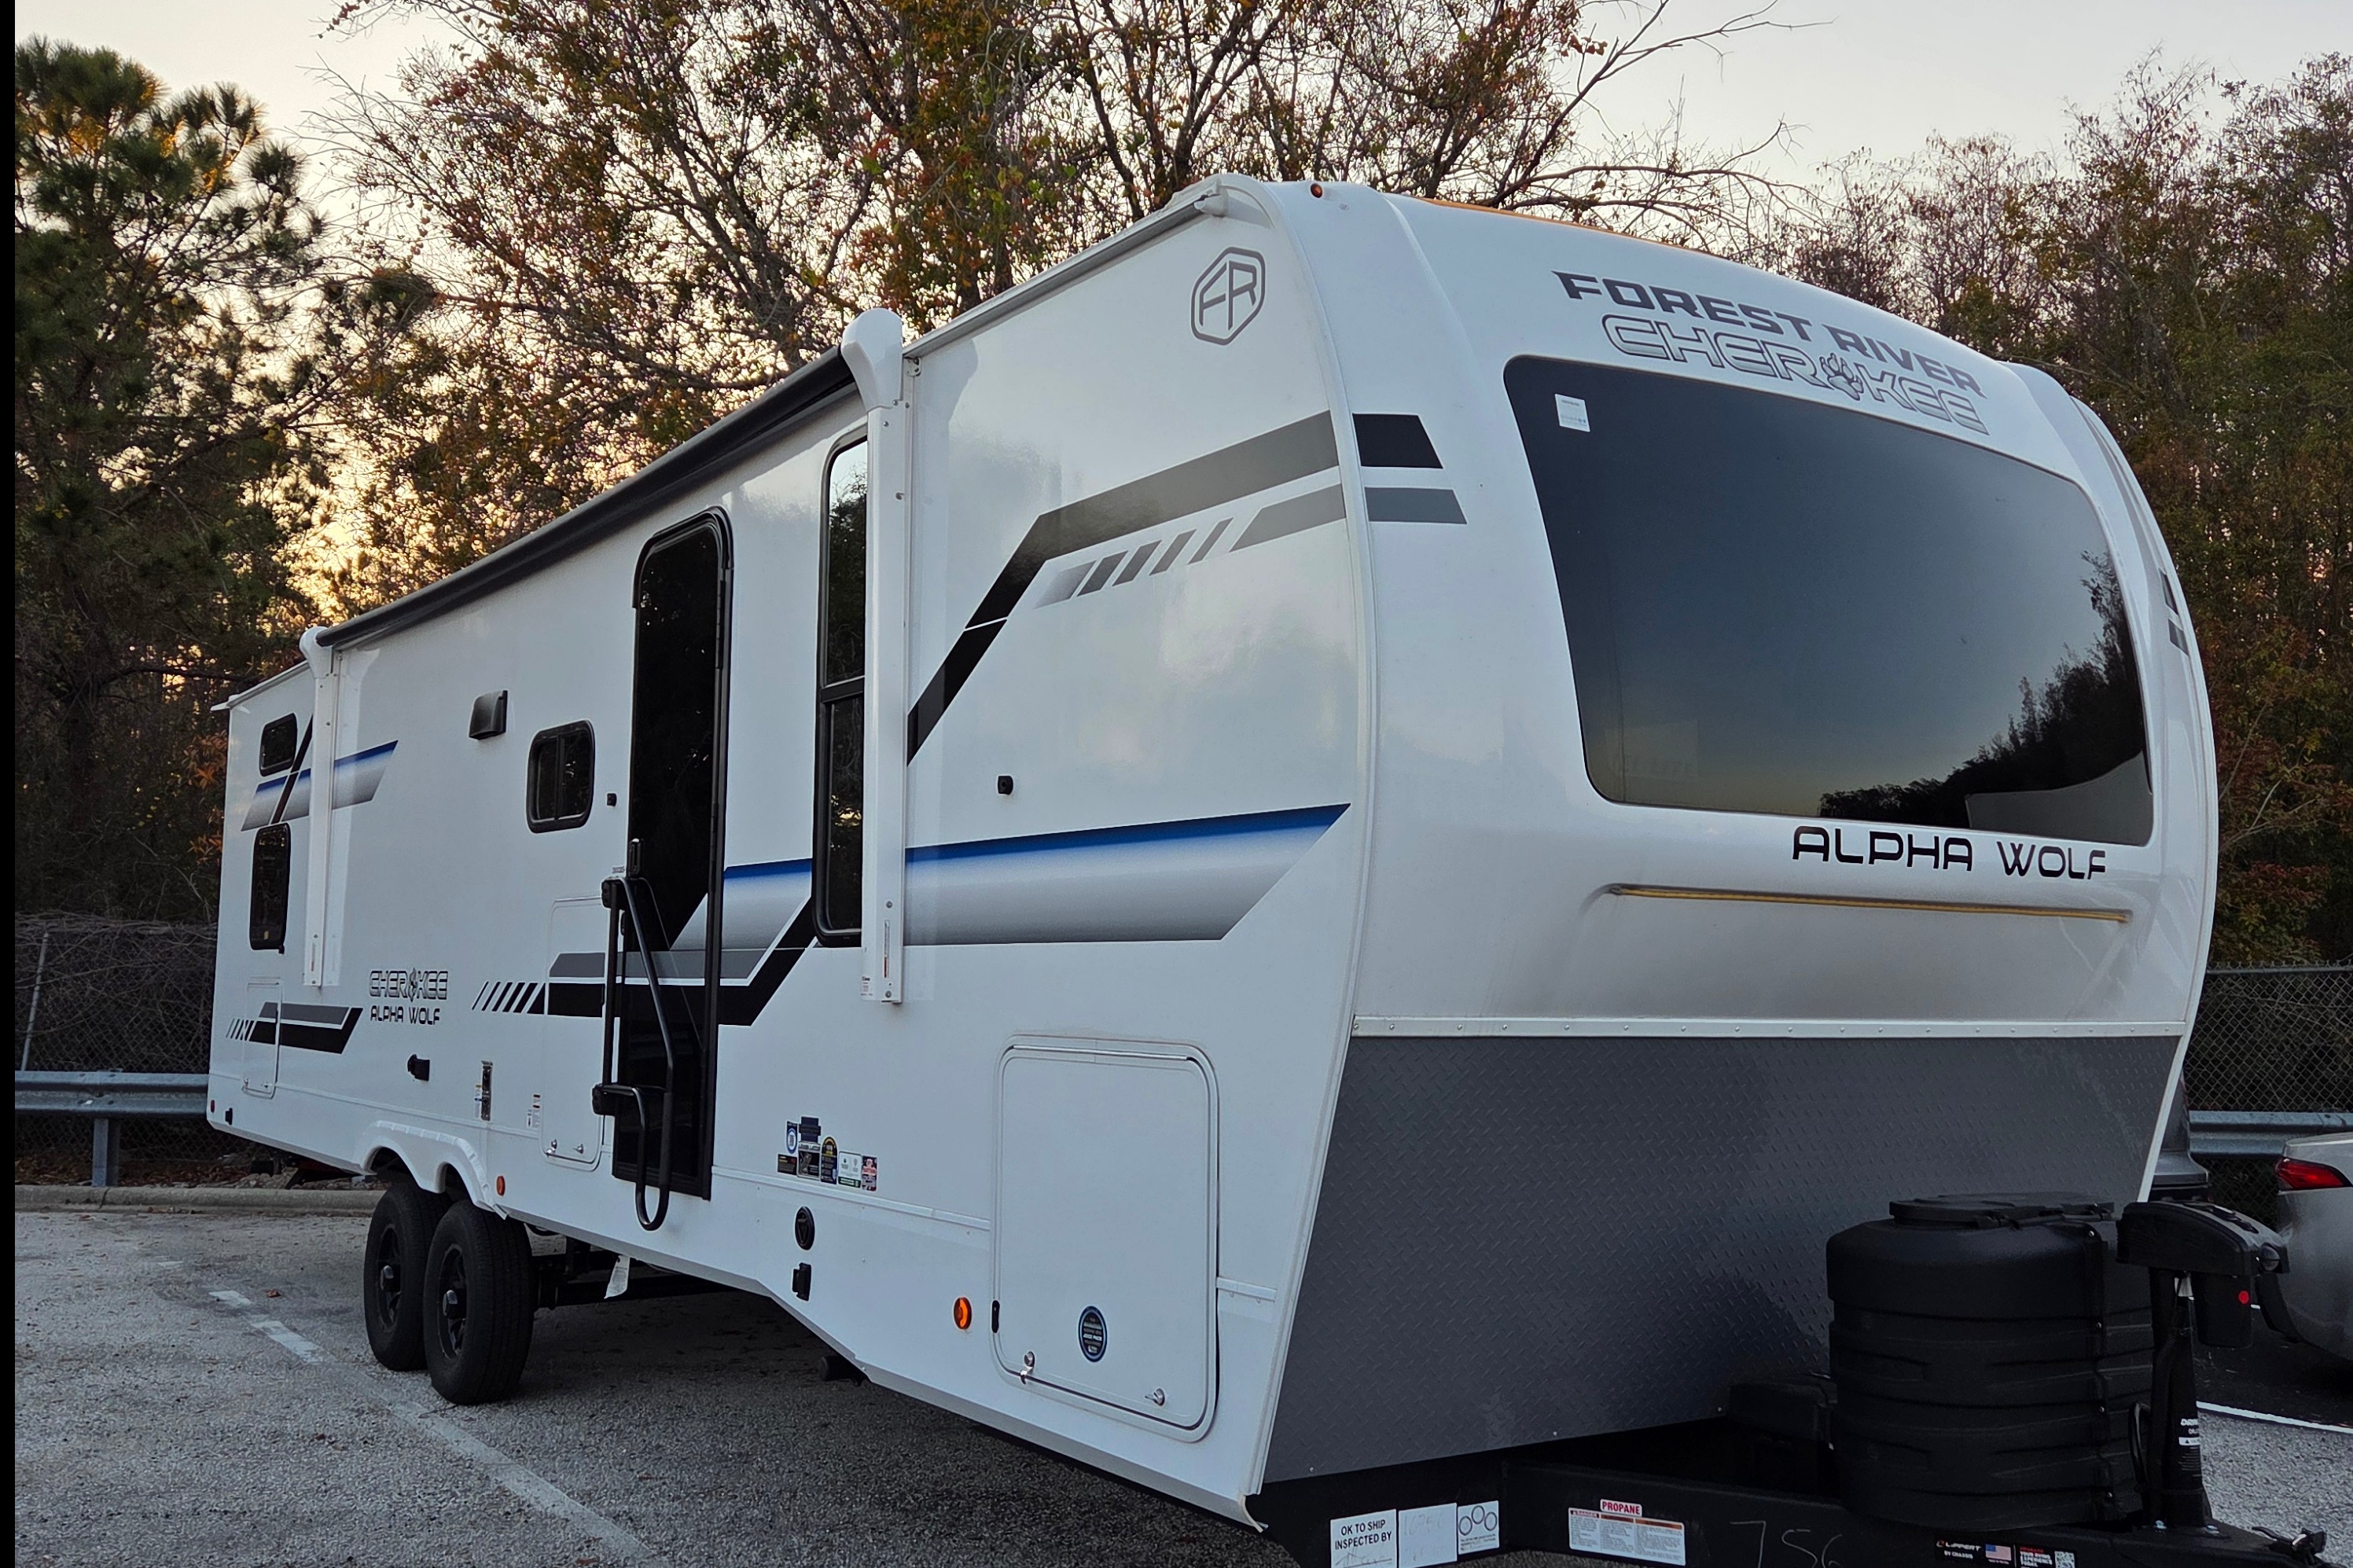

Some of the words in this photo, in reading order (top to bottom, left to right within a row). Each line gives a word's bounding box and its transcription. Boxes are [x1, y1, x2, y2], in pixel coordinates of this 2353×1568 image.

[1551, 270, 1813, 342] FOREST
[1822, 323, 1987, 398] RIVER
[1792, 825, 1973, 872] ALPHA
[1995, 840, 2107, 880] WOLF
[370, 1005, 404, 1023] ALPHA
[408, 1007, 440, 1026] WOLF
[1601, 1500, 1642, 1515] PROPANE
[1340, 1525, 1353, 1537] OK
[1355, 1522, 1366, 1534] TO
[1367, 1518, 1386, 1531] SHIP
[1334, 1533, 1380, 1550] INSPECTED
[1381, 1530, 1392, 1542] BY
